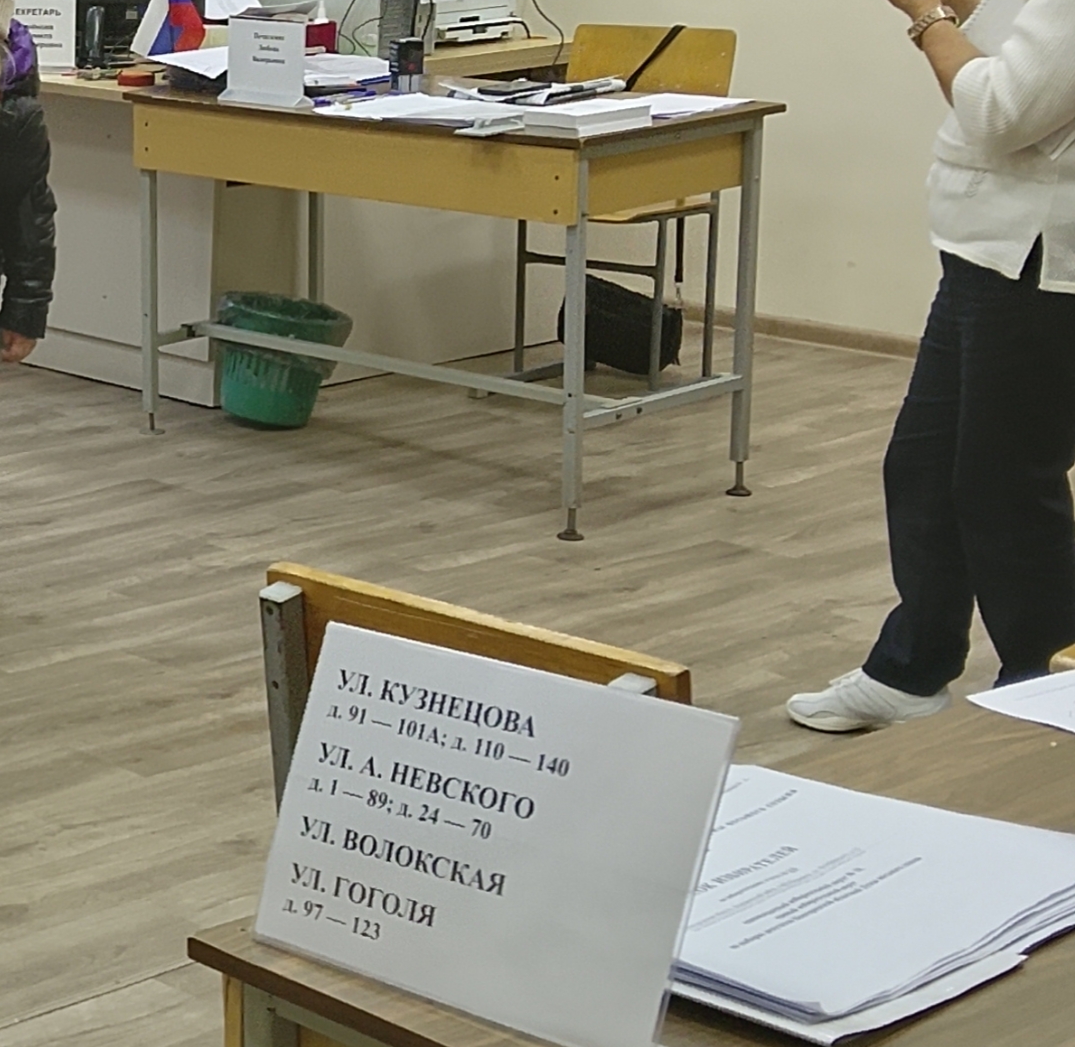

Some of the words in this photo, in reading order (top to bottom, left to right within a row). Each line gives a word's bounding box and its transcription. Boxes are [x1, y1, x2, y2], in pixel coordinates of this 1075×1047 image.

[14, 8, 62, 17] ЕКРЕТАРЬ
[337, 668, 373, 697] УЛ.
[379, 679, 535, 738] КУЗНЕЦОВА
[326, 705, 342, 719] д.
[348, 705, 366, 725] 91
[397, 718, 447, 749] 101А;
[450, 736, 466, 752] д.
[475, 738, 505, 761] 110
[536, 754, 570, 777] 140
[307, 777, 323, 792] д.
[330, 779, 338, 795] 1
[367, 789, 393, 814] 89;
[396, 803, 413, 818] д.
[418, 804, 440, 824] 24
[471, 819, 492, 839] 70
[318, 741, 353, 770] УЛ.
[359, 756, 382, 779] А.
[390, 761, 535, 820] НЕВСКОГО
[300, 815, 335, 845] УЛ.
[342, 828, 506, 896] ВОЛОКСКАЯ
[282, 899, 297, 914] д.
[303, 900, 324, 921] 97
[352, 917, 381, 940] 123
[291, 862, 326, 893] УЛ.
[333, 876, 437, 927] ГОГОЛЯ
